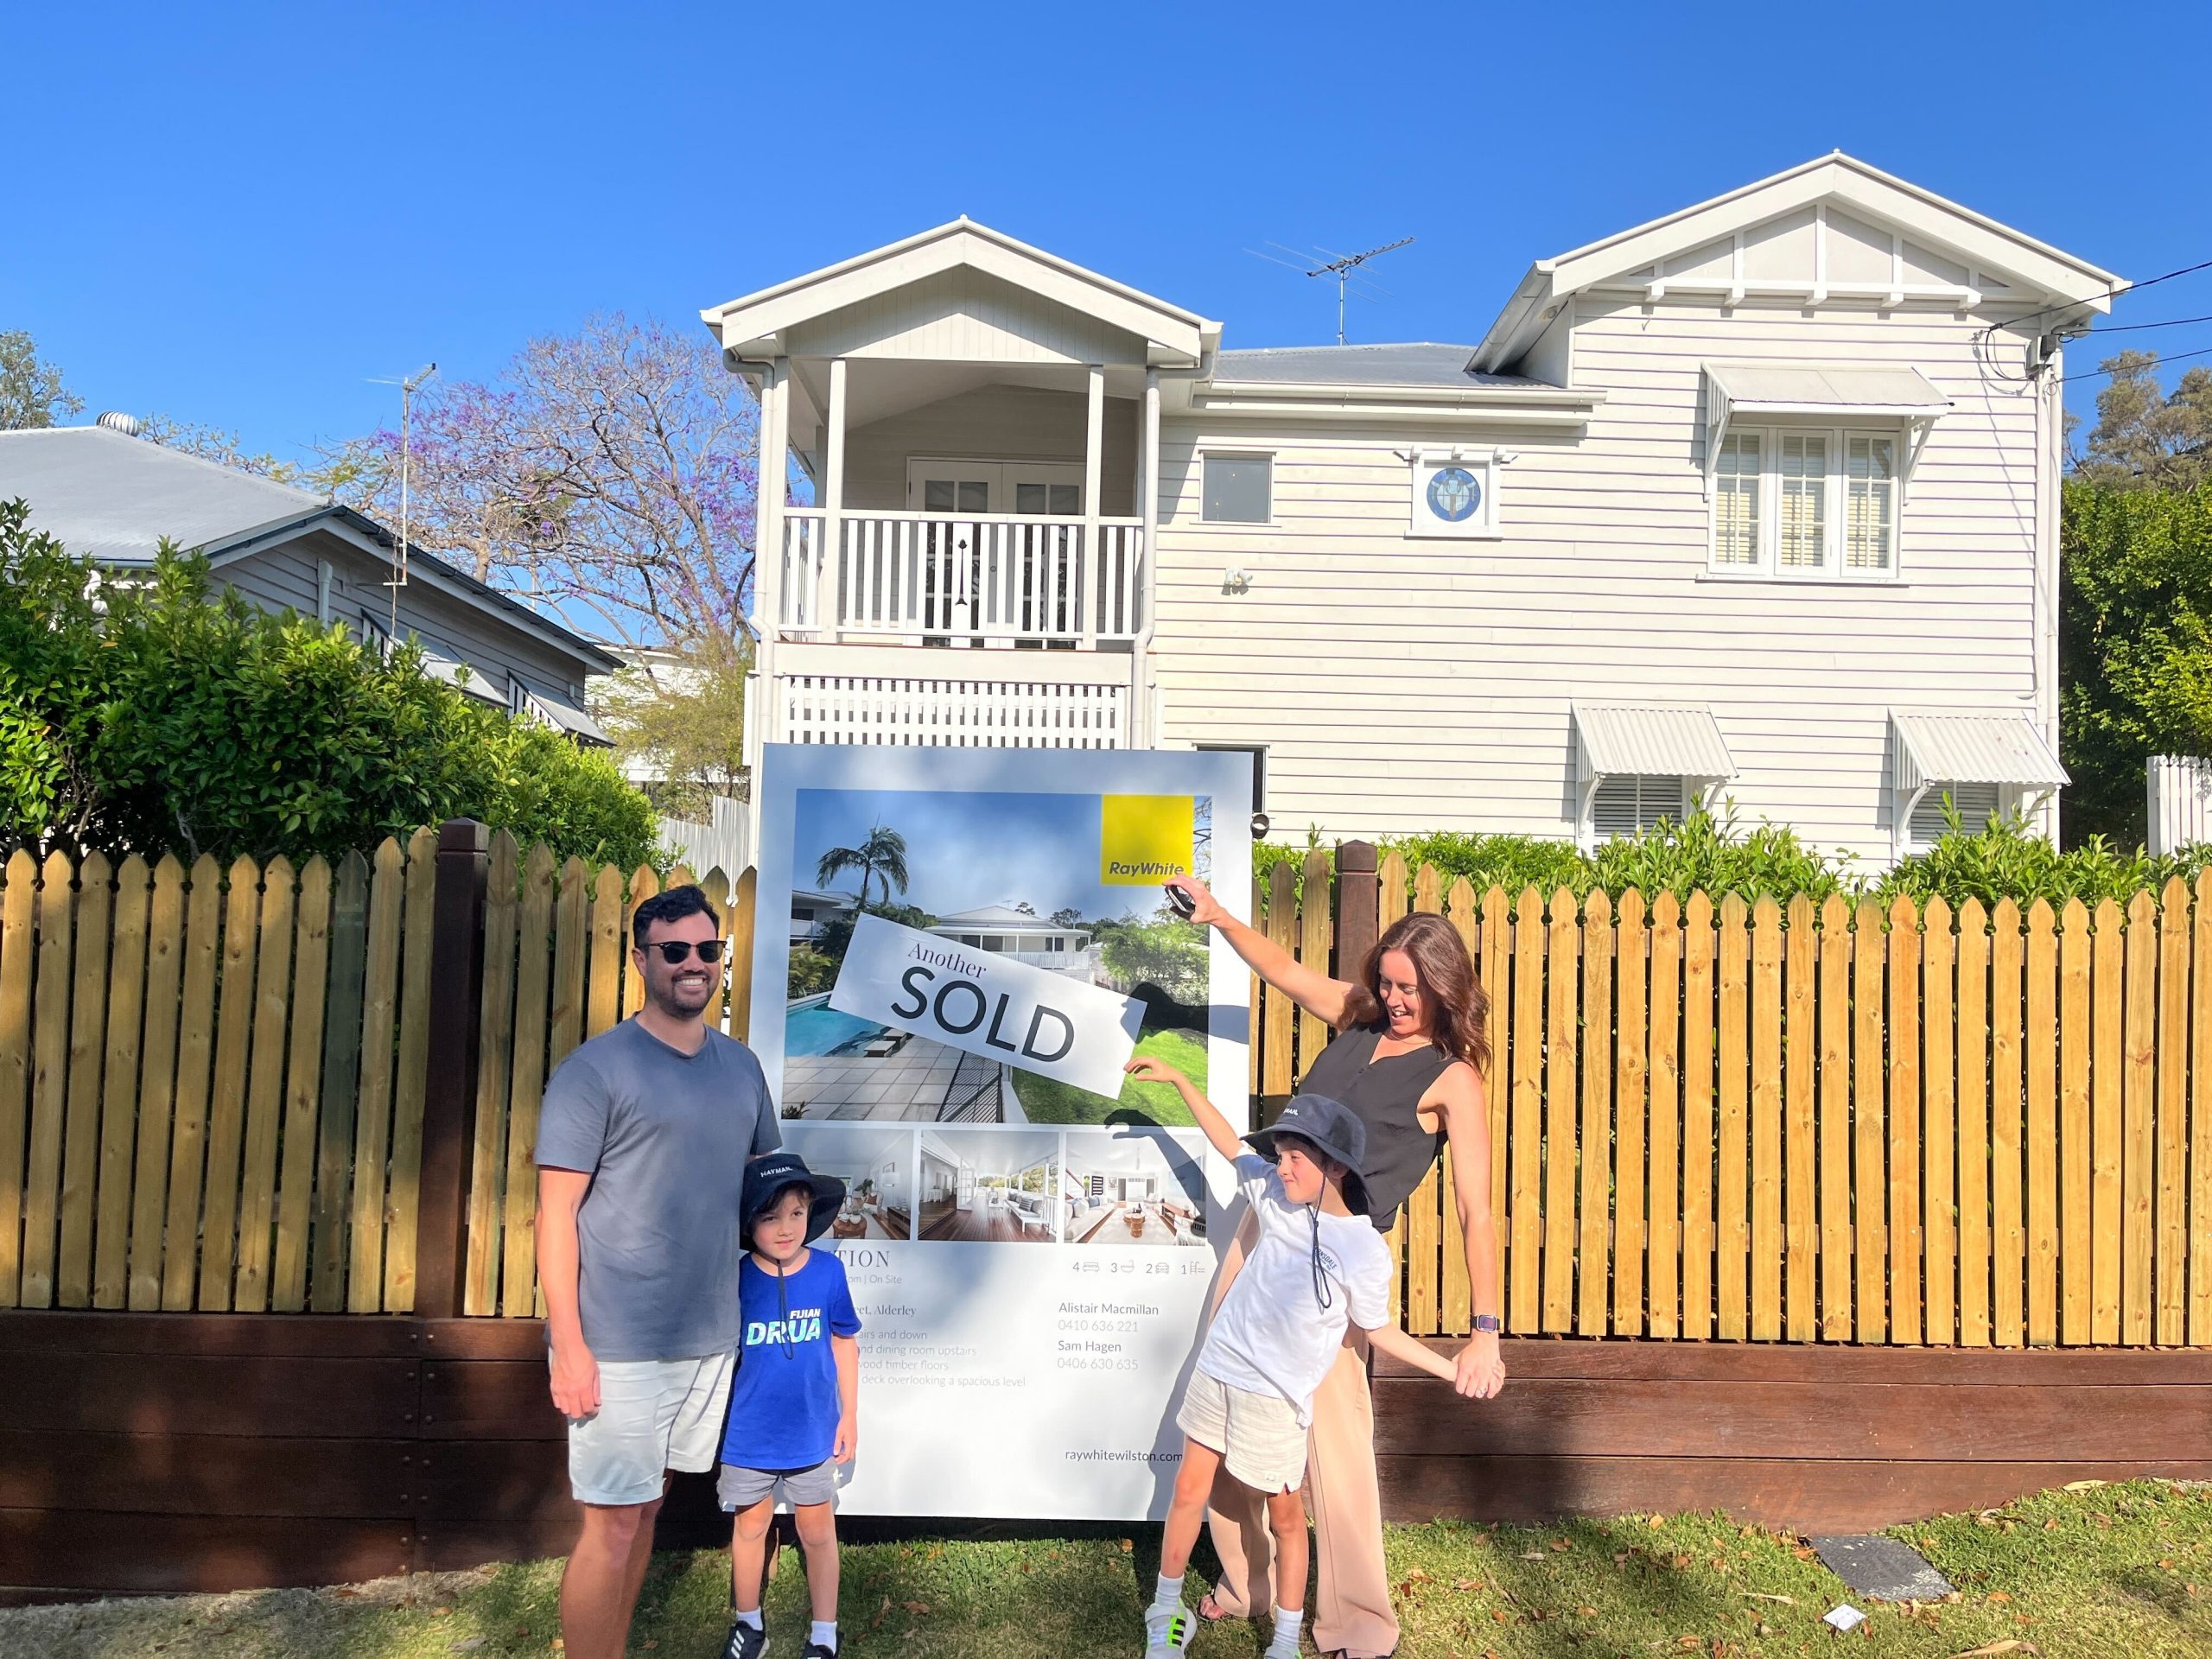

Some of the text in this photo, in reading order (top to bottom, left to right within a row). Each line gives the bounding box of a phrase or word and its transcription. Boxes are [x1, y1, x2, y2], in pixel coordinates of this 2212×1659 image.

[907, 942, 988, 978] Another
[890, 966, 1075, 1063] SOLD
[834, 1249, 890, 1268] TION
[1072, 1262, 1187, 1274] 4 3 2 1
[869, 1274, 883, 1284] On
[886, 1274, 902, 1284] Site
[789, 1308, 821, 1320] FIJIAN
[874, 1304, 917, 1318] Alderley
[1058, 1302, 1159, 1315] Alistair Macmillan
[746, 1318, 821, 1346] DRUA
[1058, 1319, 1140, 1332] 0410 636 221
[858, 1330, 927, 1340] airs and down
[860, 1344, 976, 1357] nd dining room upstairs
[1058, 1340, 1122, 1354] Sam Hagen
[886, 1360, 917, 1370] timber
[920, 1359, 949, 1370] floors
[1057, 1357, 1139, 1370] 0406 630 635
[861, 1374, 1026, 1388] deck overlooking a spacious level
